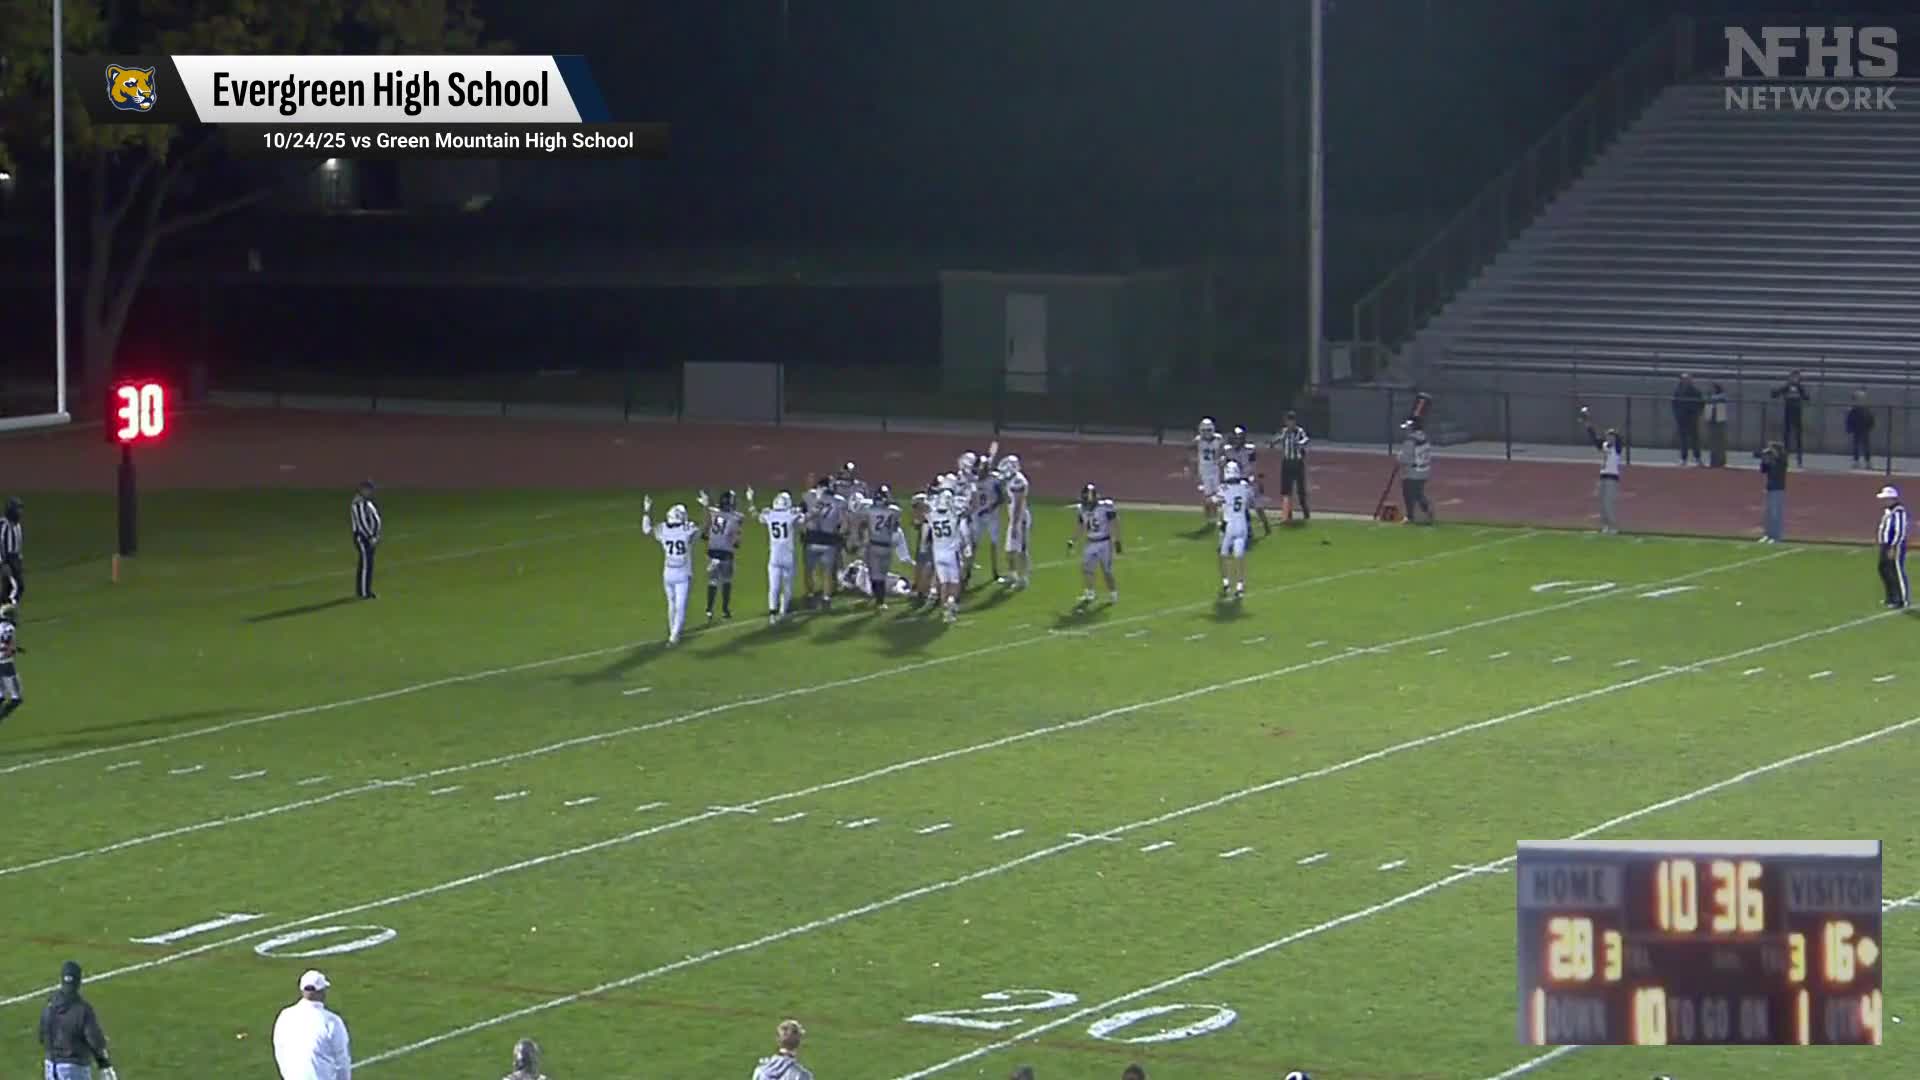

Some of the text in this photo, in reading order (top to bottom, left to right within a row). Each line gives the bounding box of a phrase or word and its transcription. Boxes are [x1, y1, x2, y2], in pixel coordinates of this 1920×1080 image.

[117, 383, 165, 440] 30
[771, 521, 789, 539] 51
[874, 514, 893, 530] 24
[932, 519, 953, 538] 55
[1657, 859, 1764, 933] 10 36
[1549, 917, 1594, 981] 28
[1604, 930, 1622, 981] 3
[1788, 933, 1806, 983] 3
[1824, 920, 1854, 983] 16
